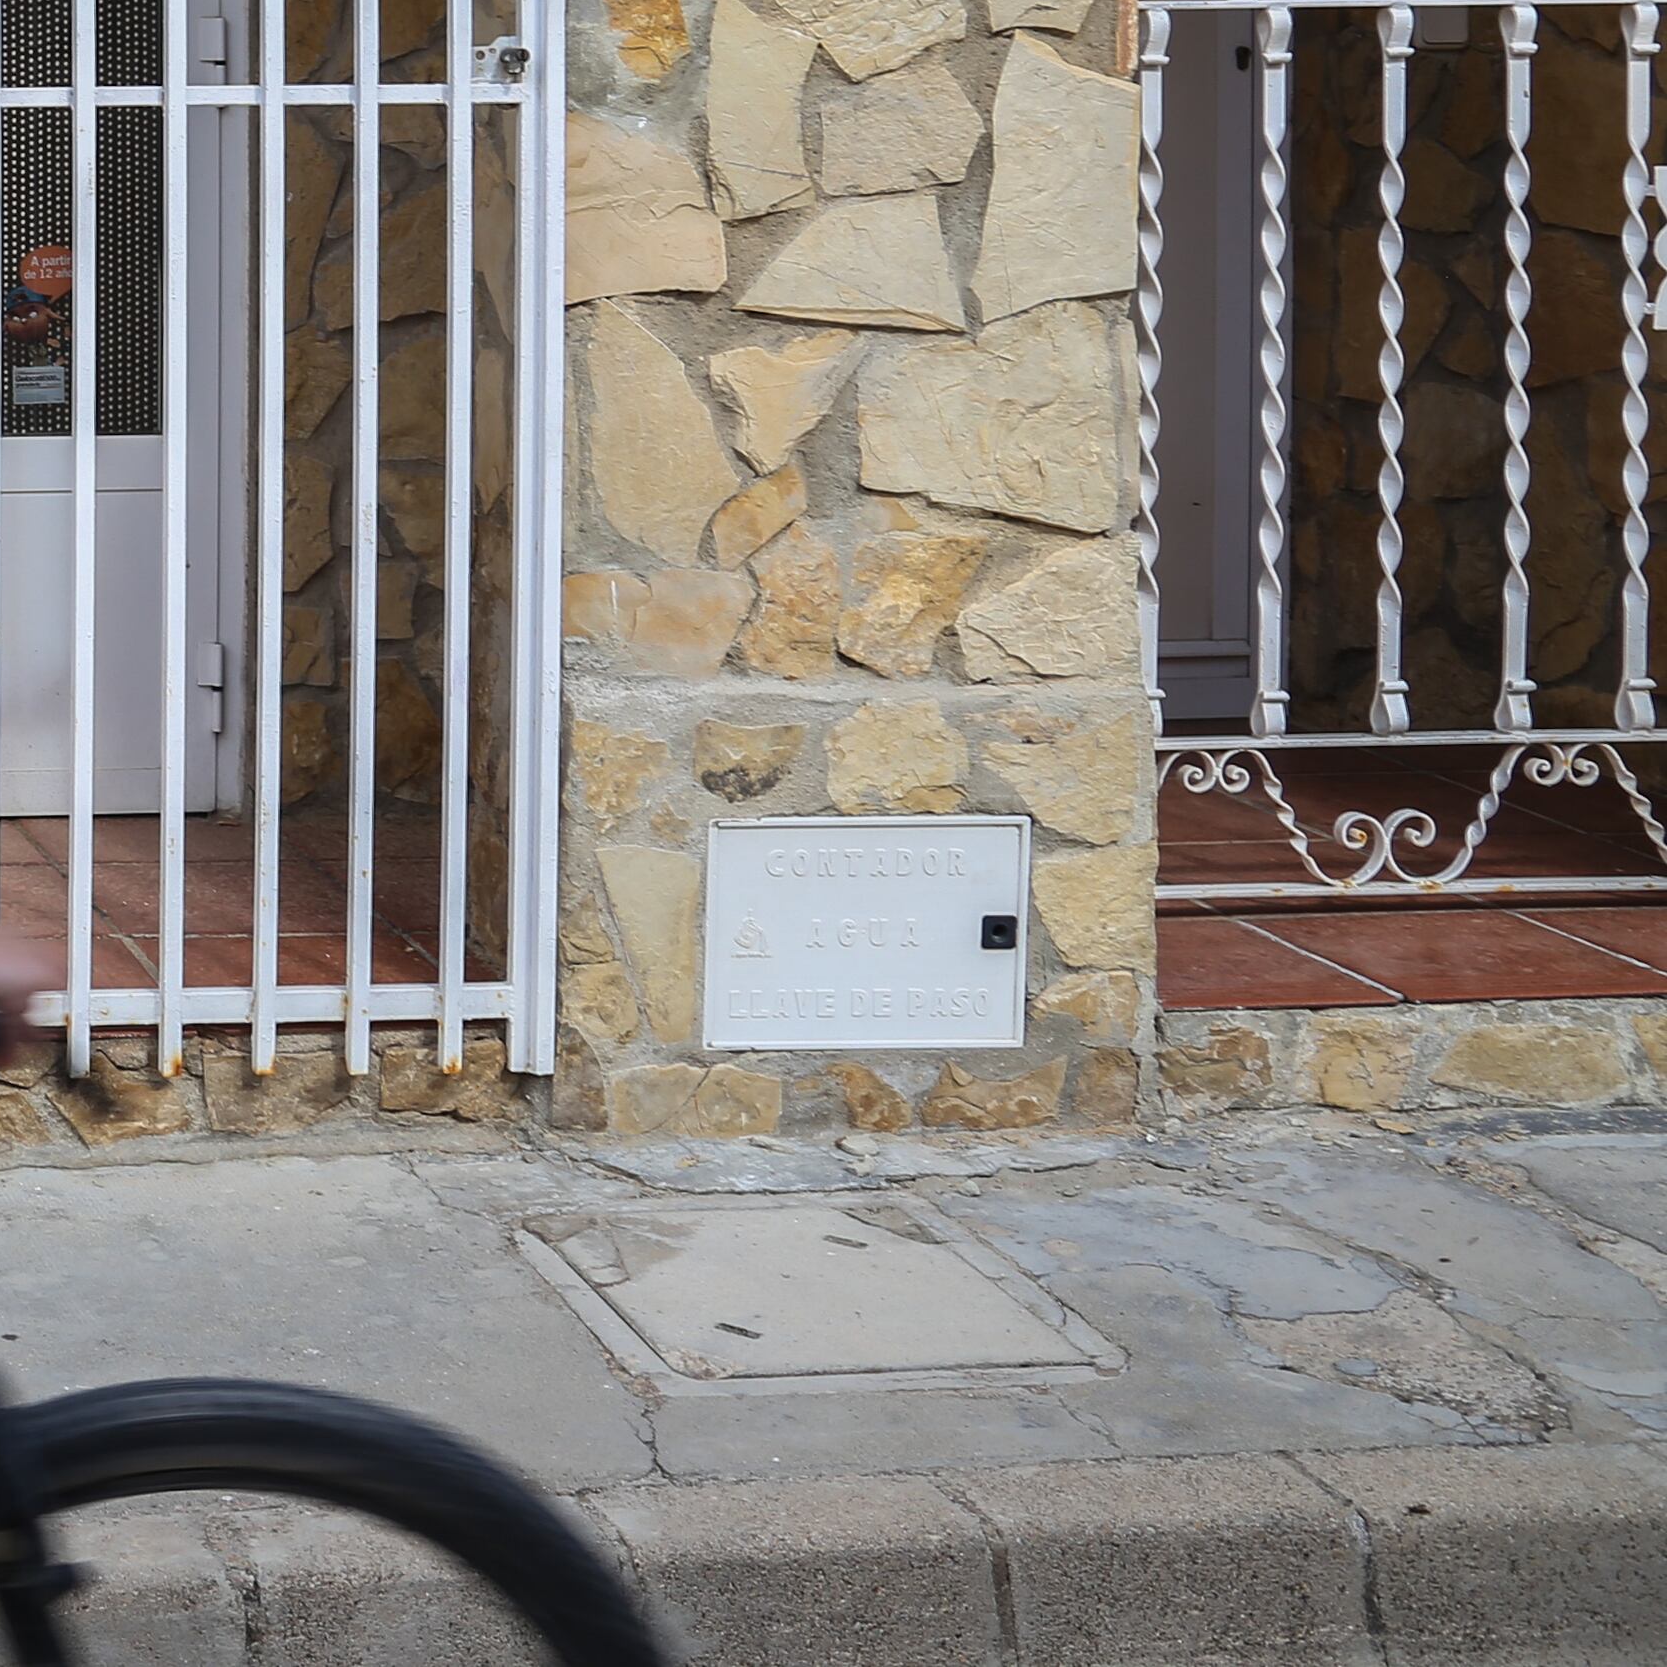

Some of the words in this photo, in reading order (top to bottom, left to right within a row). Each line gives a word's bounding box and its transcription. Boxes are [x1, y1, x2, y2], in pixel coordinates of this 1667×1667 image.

[23, 270, 37, 280] de
[40, 269, 53, 279] 12
[30, 256, 39, 266] A
[764, 847, 968, 878] CONTADOR
[805, 918, 920, 948] AGUA
[728, 989, 837, 1019] LLAVE
[849, 989, 893, 1018] DE
[906, 988, 990, 1018] PASO
